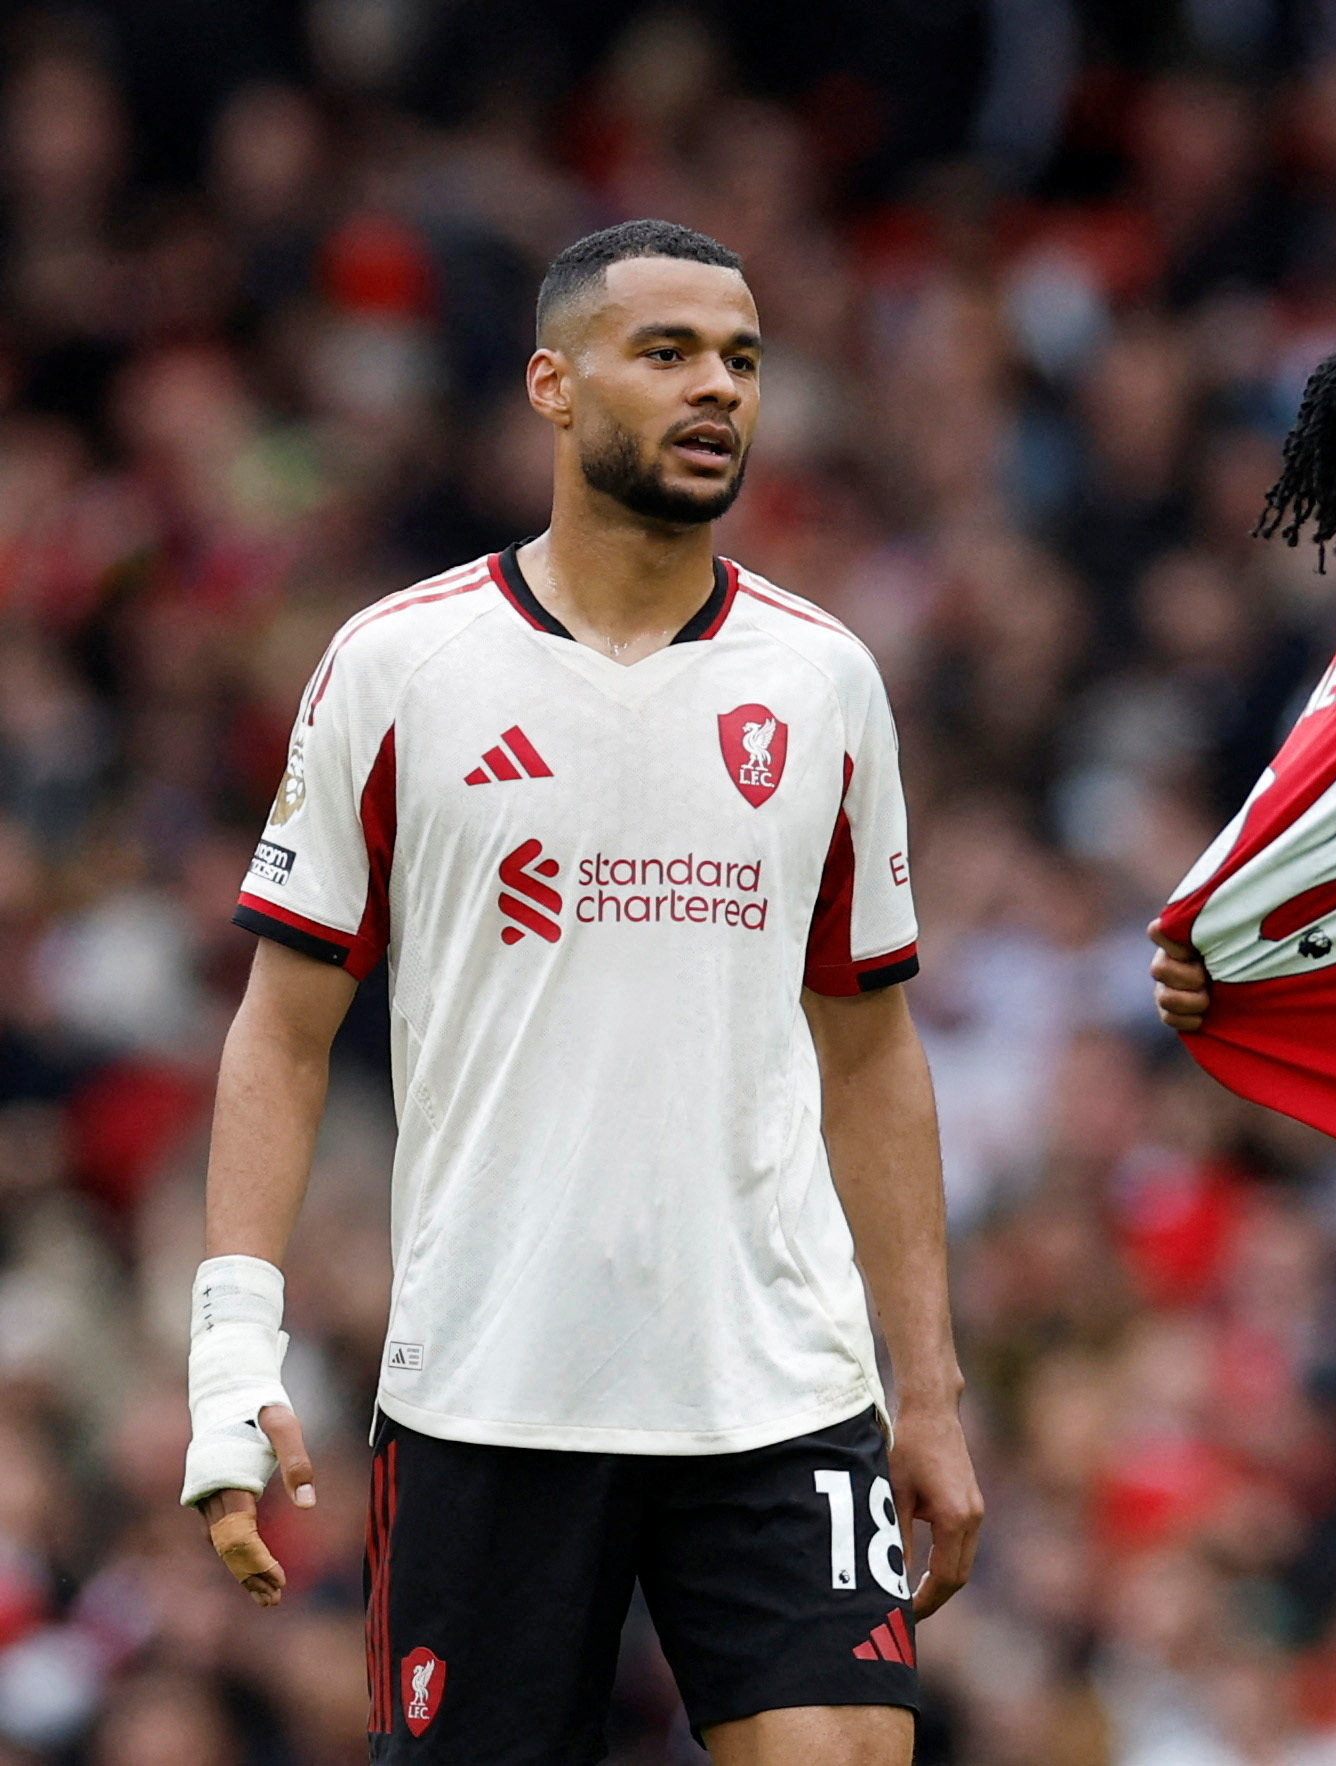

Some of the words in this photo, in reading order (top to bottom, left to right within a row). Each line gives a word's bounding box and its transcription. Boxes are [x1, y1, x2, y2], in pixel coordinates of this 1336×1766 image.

[578, 852, 762, 892] standard
[576, 888, 769, 931] chartered
[814, 1470, 911, 1600] 18
